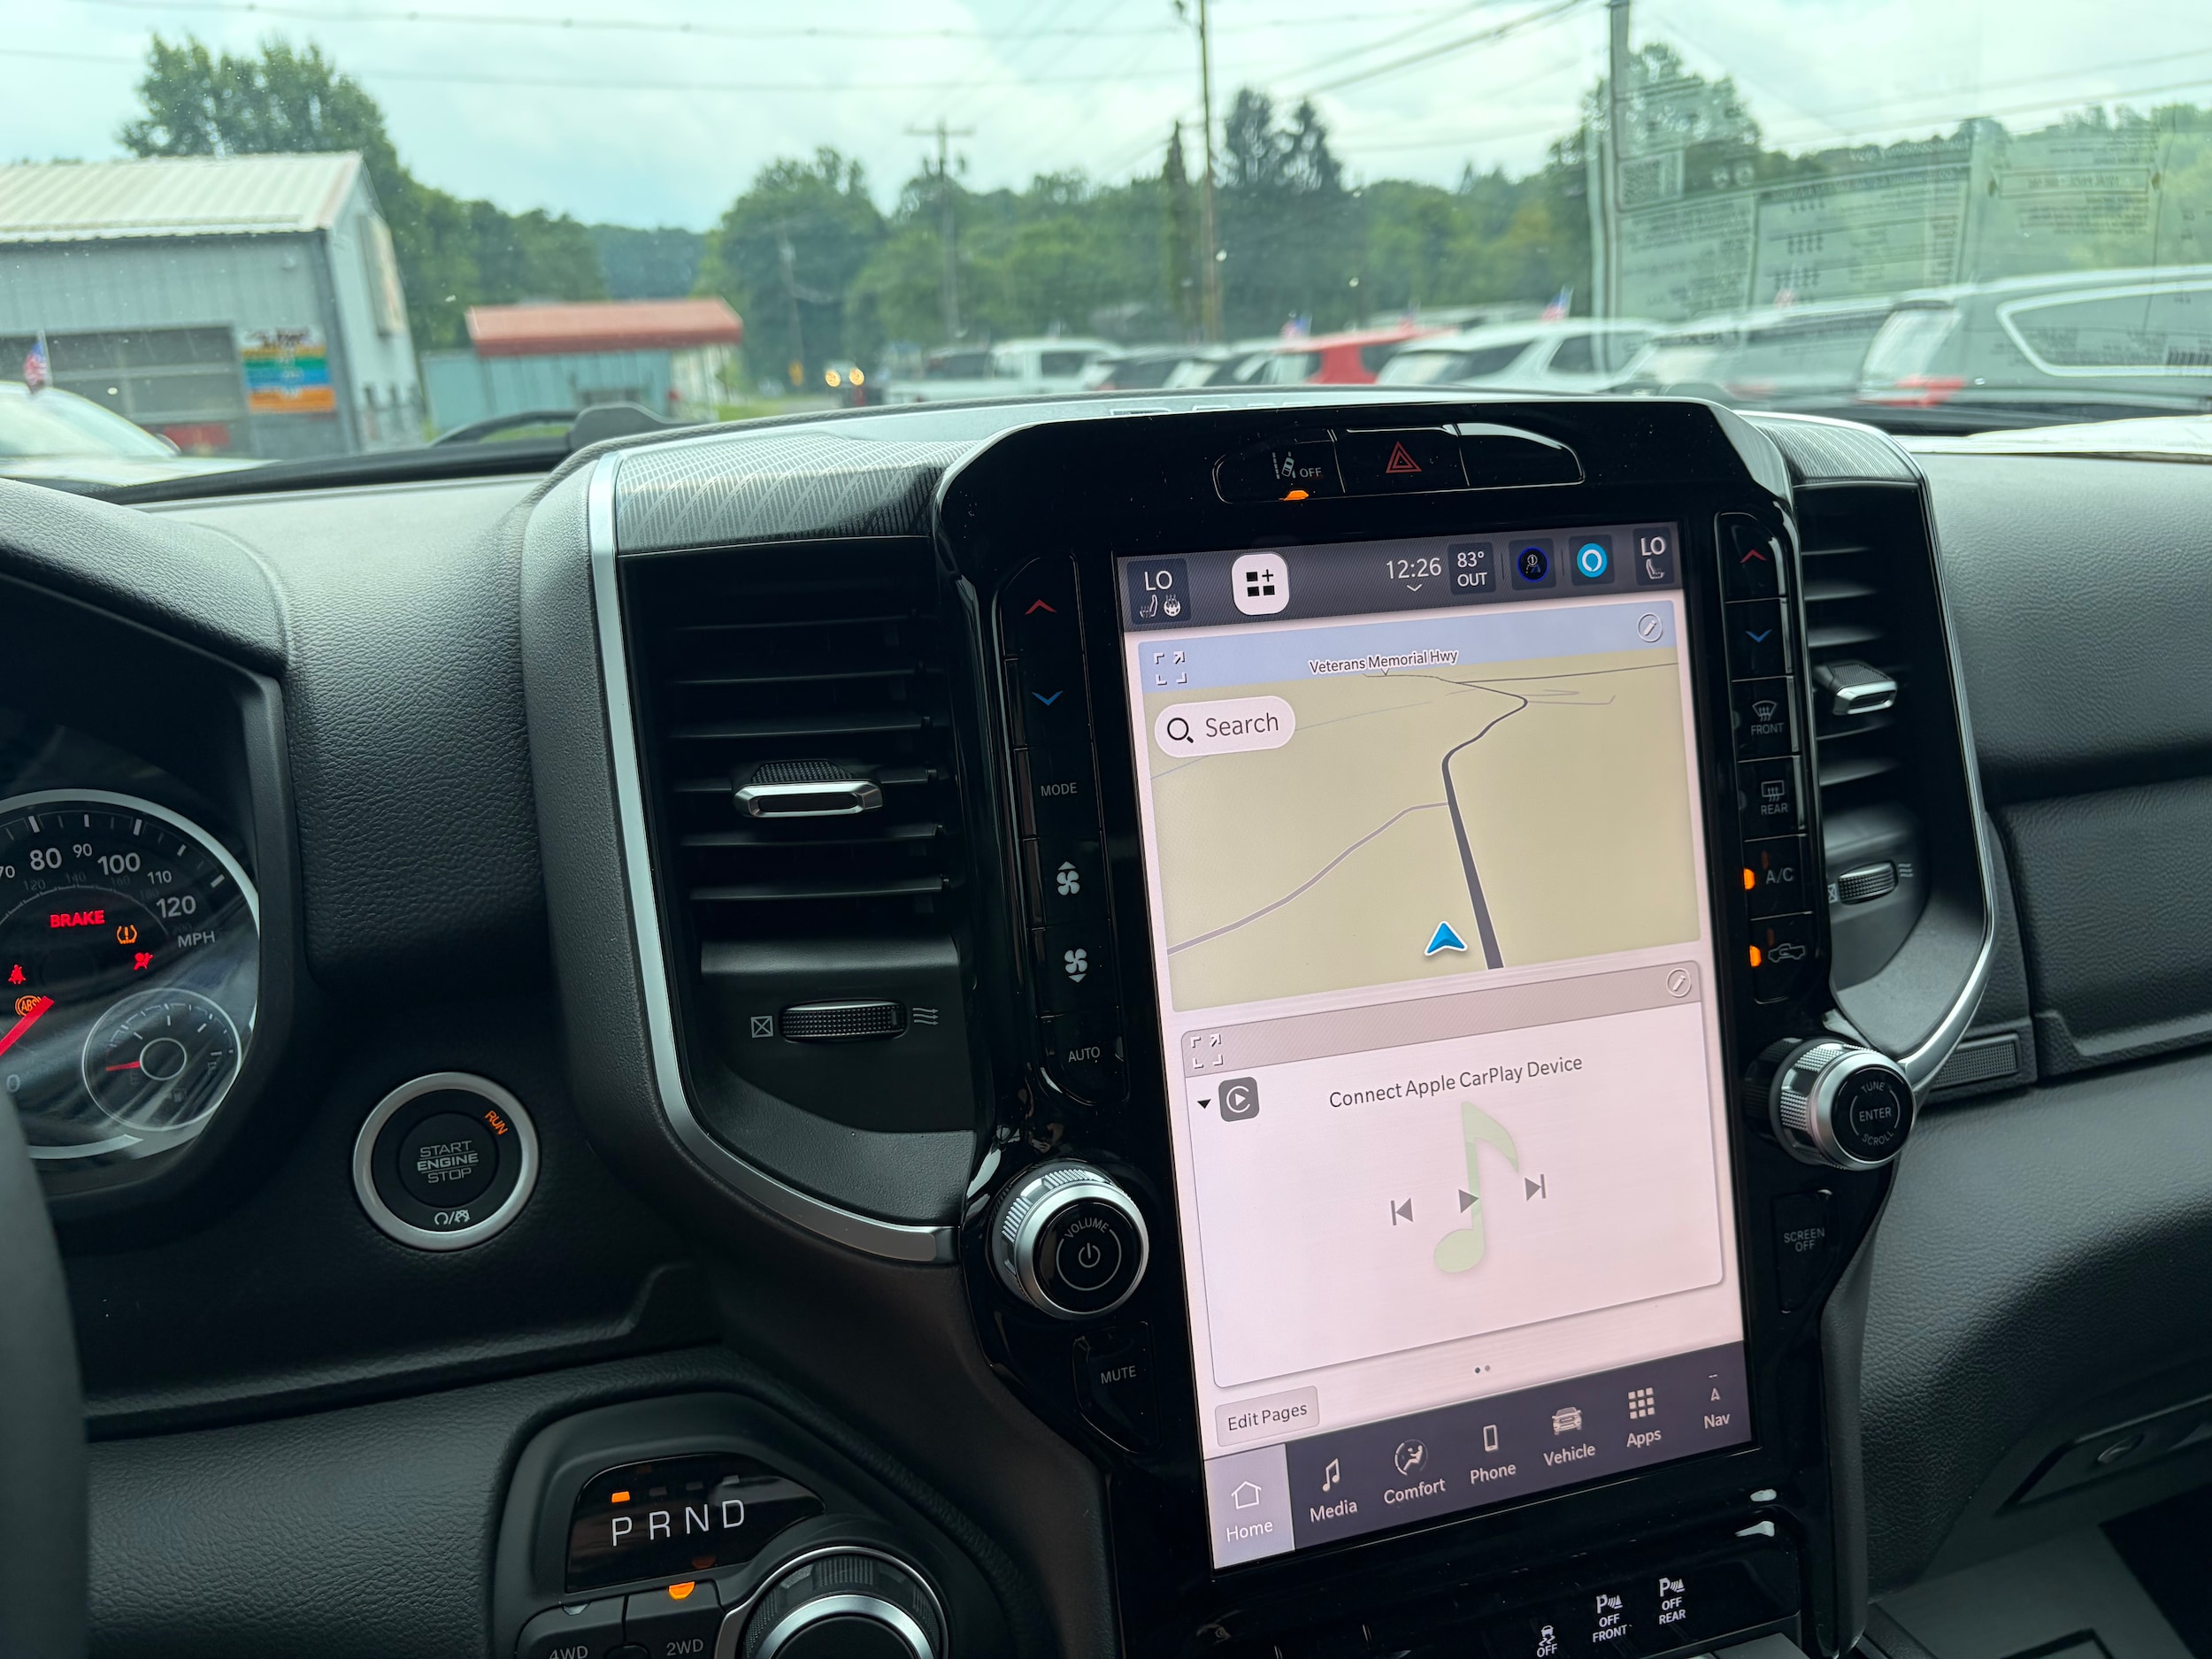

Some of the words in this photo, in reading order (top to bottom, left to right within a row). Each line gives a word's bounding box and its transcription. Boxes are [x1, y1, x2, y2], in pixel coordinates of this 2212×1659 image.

[1299, 467, 1322, 478] OFF
[1640, 536, 1666, 557] LO
[1386, 557, 1442, 580] 12:26
[1144, 571, 1173, 591] LO
[1457, 572, 1487, 588] OUT
[1310, 657, 1365, 674] Veterans
[1368, 650, 1427, 669] Memorial
[1430, 649, 1458, 666] Hwy
[1205, 713, 1279, 738] Search
[1750, 722, 1785, 736] FRONT
[1041, 782, 1078, 797] MODE
[1760, 803, 1789, 815] REAR
[29, 847, 63, 872] 80
[73, 842, 94, 859] 90
[97, 851, 142, 876] 100
[147, 870, 173, 885] 110
[1765, 866, 1795, 885] A/C
[156, 895, 196, 918] 120
[50, 909, 106, 929] BRAKE
[178, 930, 215, 949] MPH
[1068, 1047, 1101, 1062] AUTO
[6, 1074, 20, 1093] 0
[1329, 1082, 1402, 1110] Connect
[1405, 1074, 1455, 1101] Apple
[1459, 1064, 1524, 1090] CarPlay
[1527, 1055, 1583, 1079] Device
[1860, 1079, 1886, 1094] TUNE
[484, 1110, 509, 1135] RUN
[1859, 1106, 1892, 1123] ENTER
[1861, 1129, 1894, 1147] SCROLL
[419, 1140, 472, 1157] START
[417, 1152, 479, 1171] ENGINE
[427, 1167, 472, 1184] STOP
[1064, 1217, 1110, 1240] VOLUME
[1783, 1226, 1825, 1244] SCREEN
[1794, 1240, 1815, 1253] OFF
[1100, 1365, 1137, 1384] MUTE
[1227, 1412, 1259, 1432] Edit
[1262, 1402, 1308, 1429] Pages
[1703, 1411, 1731, 1430] Nav
[1626, 1427, 1662, 1450] Apps
[1543, 1442, 1596, 1468] Vehicle
[1470, 1461, 1517, 1485] Phone
[1384, 1477, 1446, 1505] Comfort
[1310, 1498, 1358, 1524] Media
[1225, 1517, 1273, 1543] Home
[1662, 1596, 1682, 1610] OFF
[1599, 1613, 1620, 1628] OFF
[1659, 1609, 1686, 1625] REAR
[1593, 1624, 1628, 1643] FRONT
[549, 1646, 589, 1659] 4WD
[665, 1638, 704, 1656] 2WD
[1537, 1643, 1557, 1658] OFF
